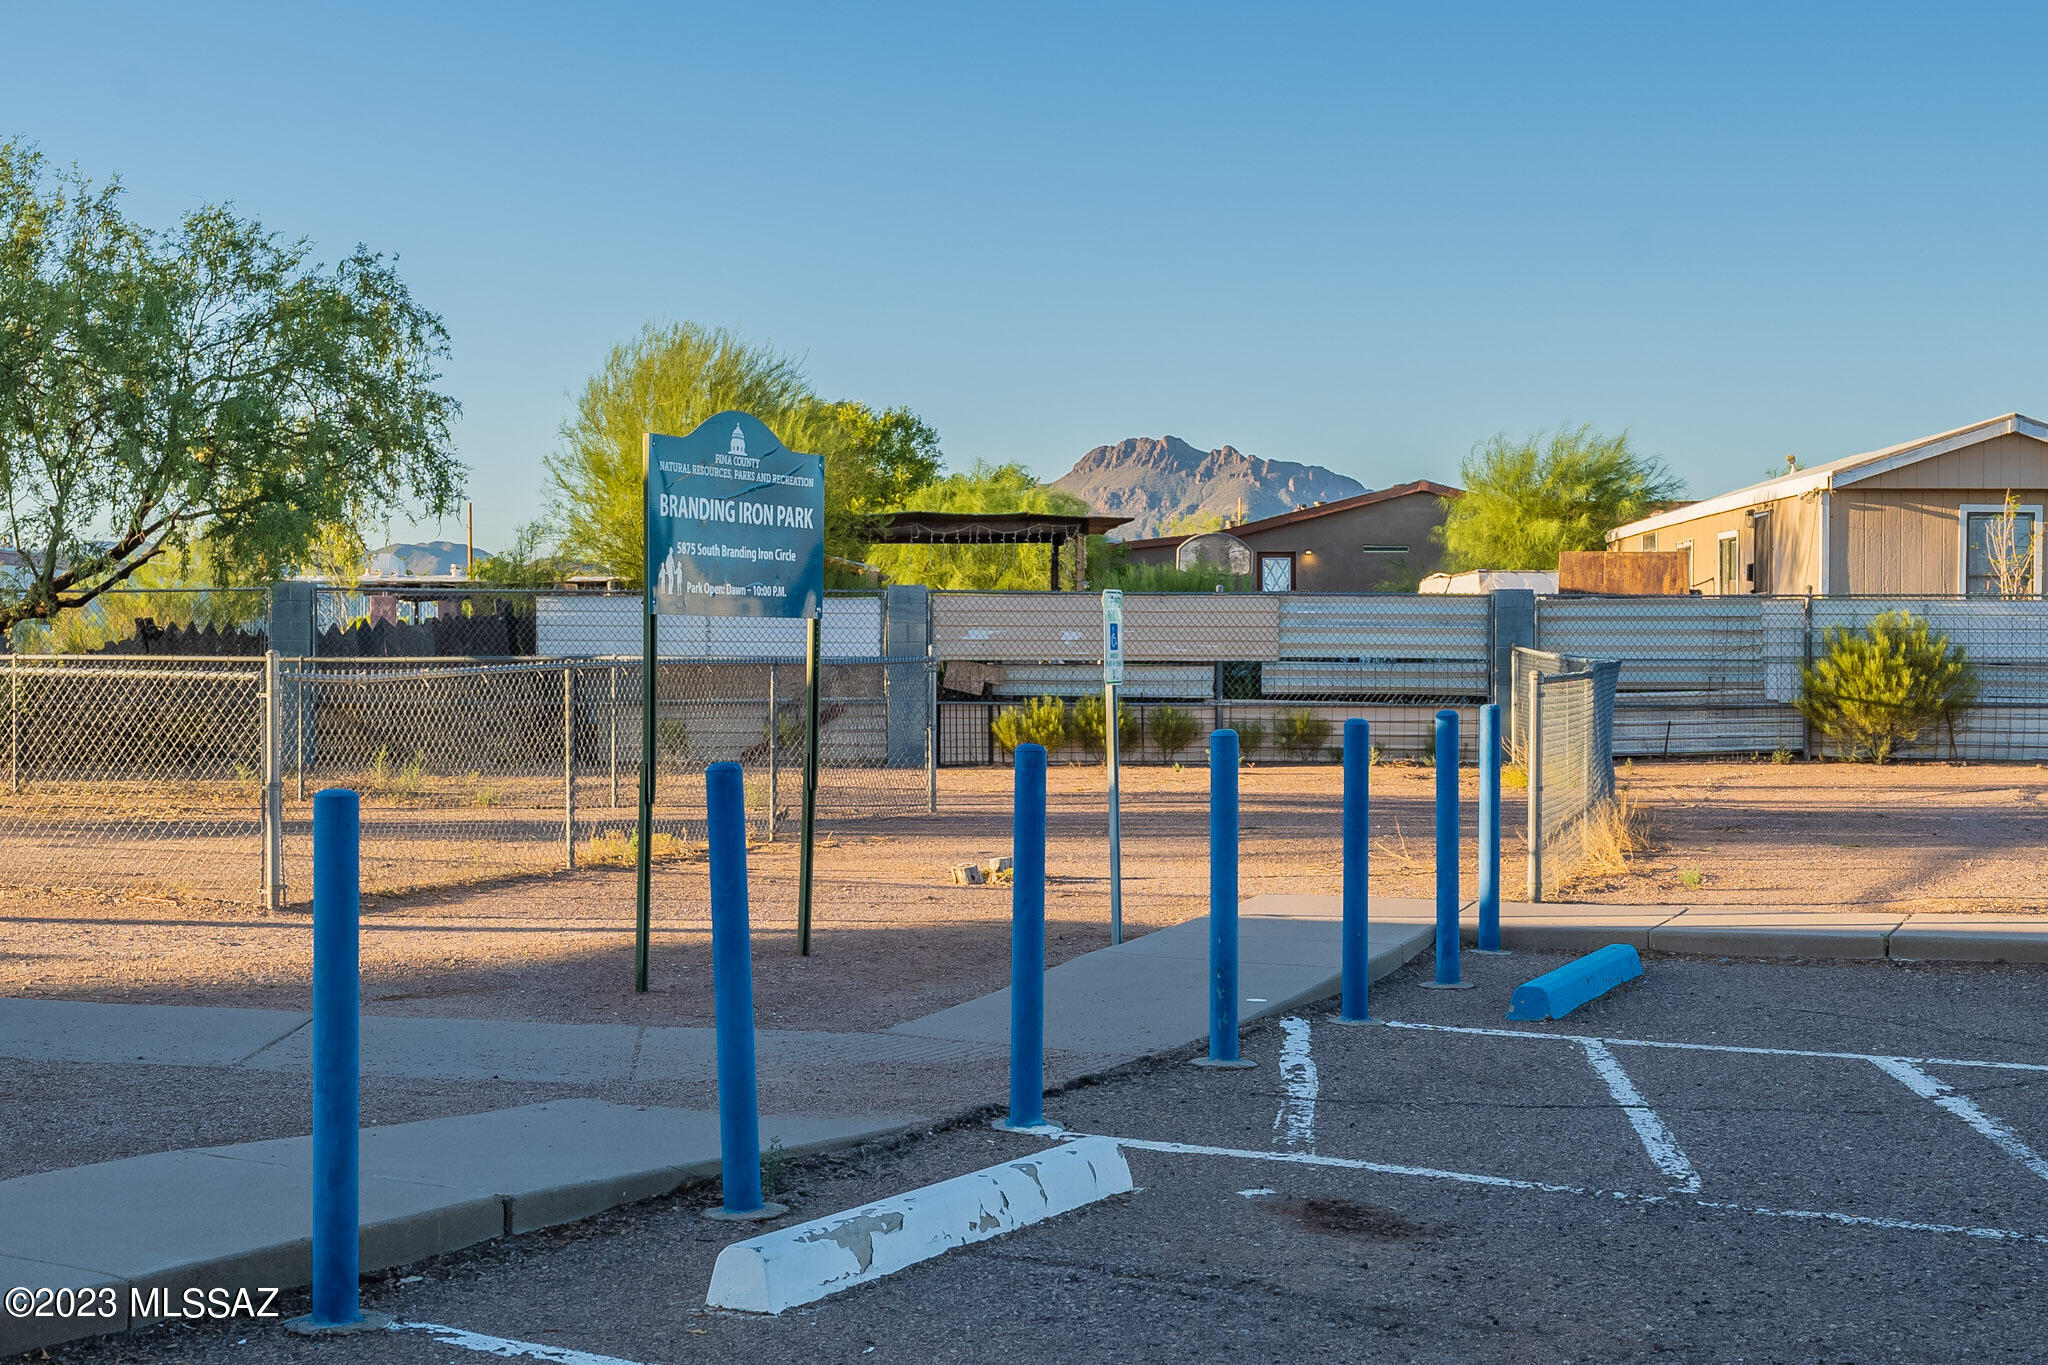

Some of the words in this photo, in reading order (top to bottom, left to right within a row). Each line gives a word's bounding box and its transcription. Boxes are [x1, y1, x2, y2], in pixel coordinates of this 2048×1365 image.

[715, 454, 732, 465] PIMA
[734, 456, 760, 468] COUNTY
[659, 461, 691, 474] NATURAL
[692, 465, 733, 479] RESOURCES,
[734, 470, 755, 480] PARKS
[757, 473, 771, 482] AND
[772, 475, 814, 487] RECREATION
[660, 494, 735, 522] BRANDING
[739, 502, 773, 525] IRON
[777, 506, 813, 529] PARK
[677, 542, 695, 555] 5875
[697, 544, 720, 557] South
[722, 545, 757, 562] Branding
[758, 549, 773, 560] Iron
[775, 549, 796, 561] Circle
[687, 582, 702, 593] Park
[704, 583, 725, 597] Open:
[727, 584, 746, 595] Dawn
[753, 585, 771, 596] 10:00
[773, 586, 787, 597] P.M.
